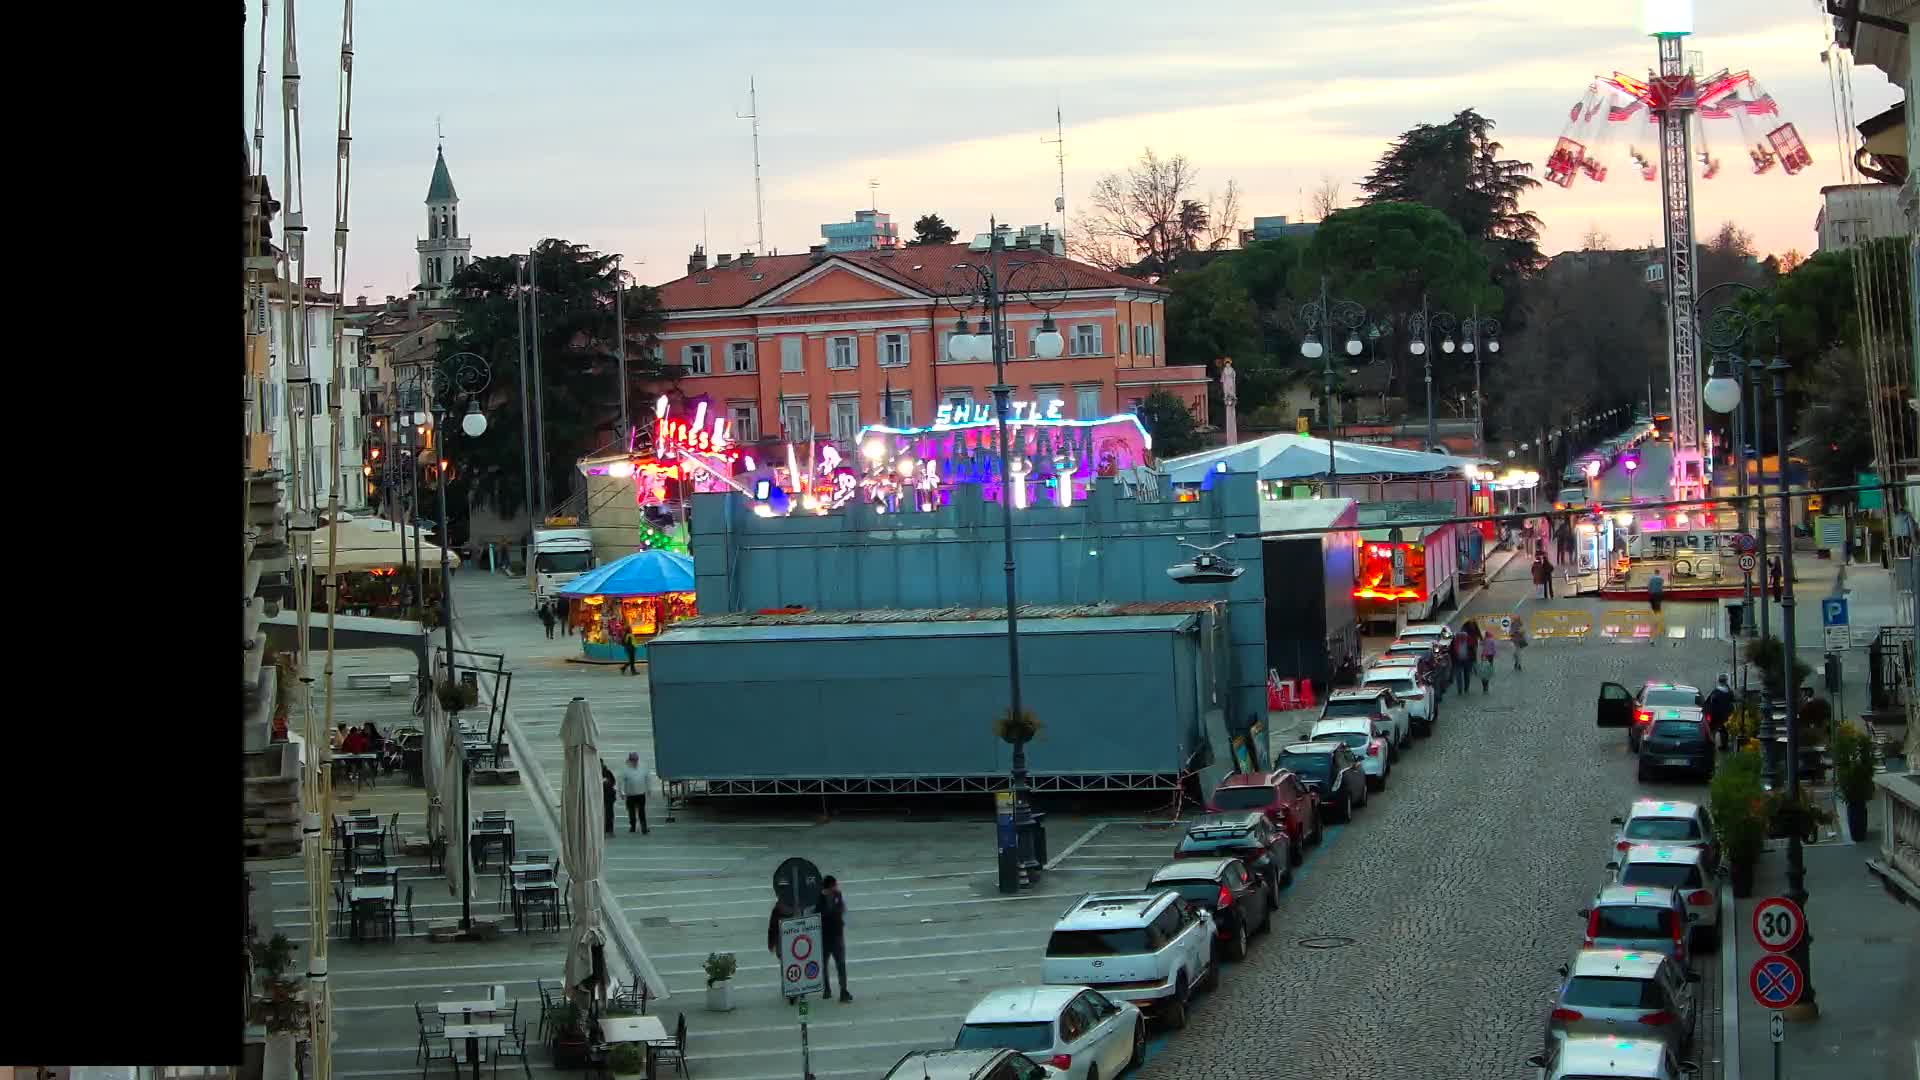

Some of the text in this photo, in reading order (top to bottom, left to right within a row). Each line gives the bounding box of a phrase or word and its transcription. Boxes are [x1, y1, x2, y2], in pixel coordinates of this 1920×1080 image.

[935, 399, 1065, 424] SHUTLE
[1742, 557, 1753, 567] 20
[1828, 602, 1842, 622] P
[1762, 912, 1791, 937] 30
